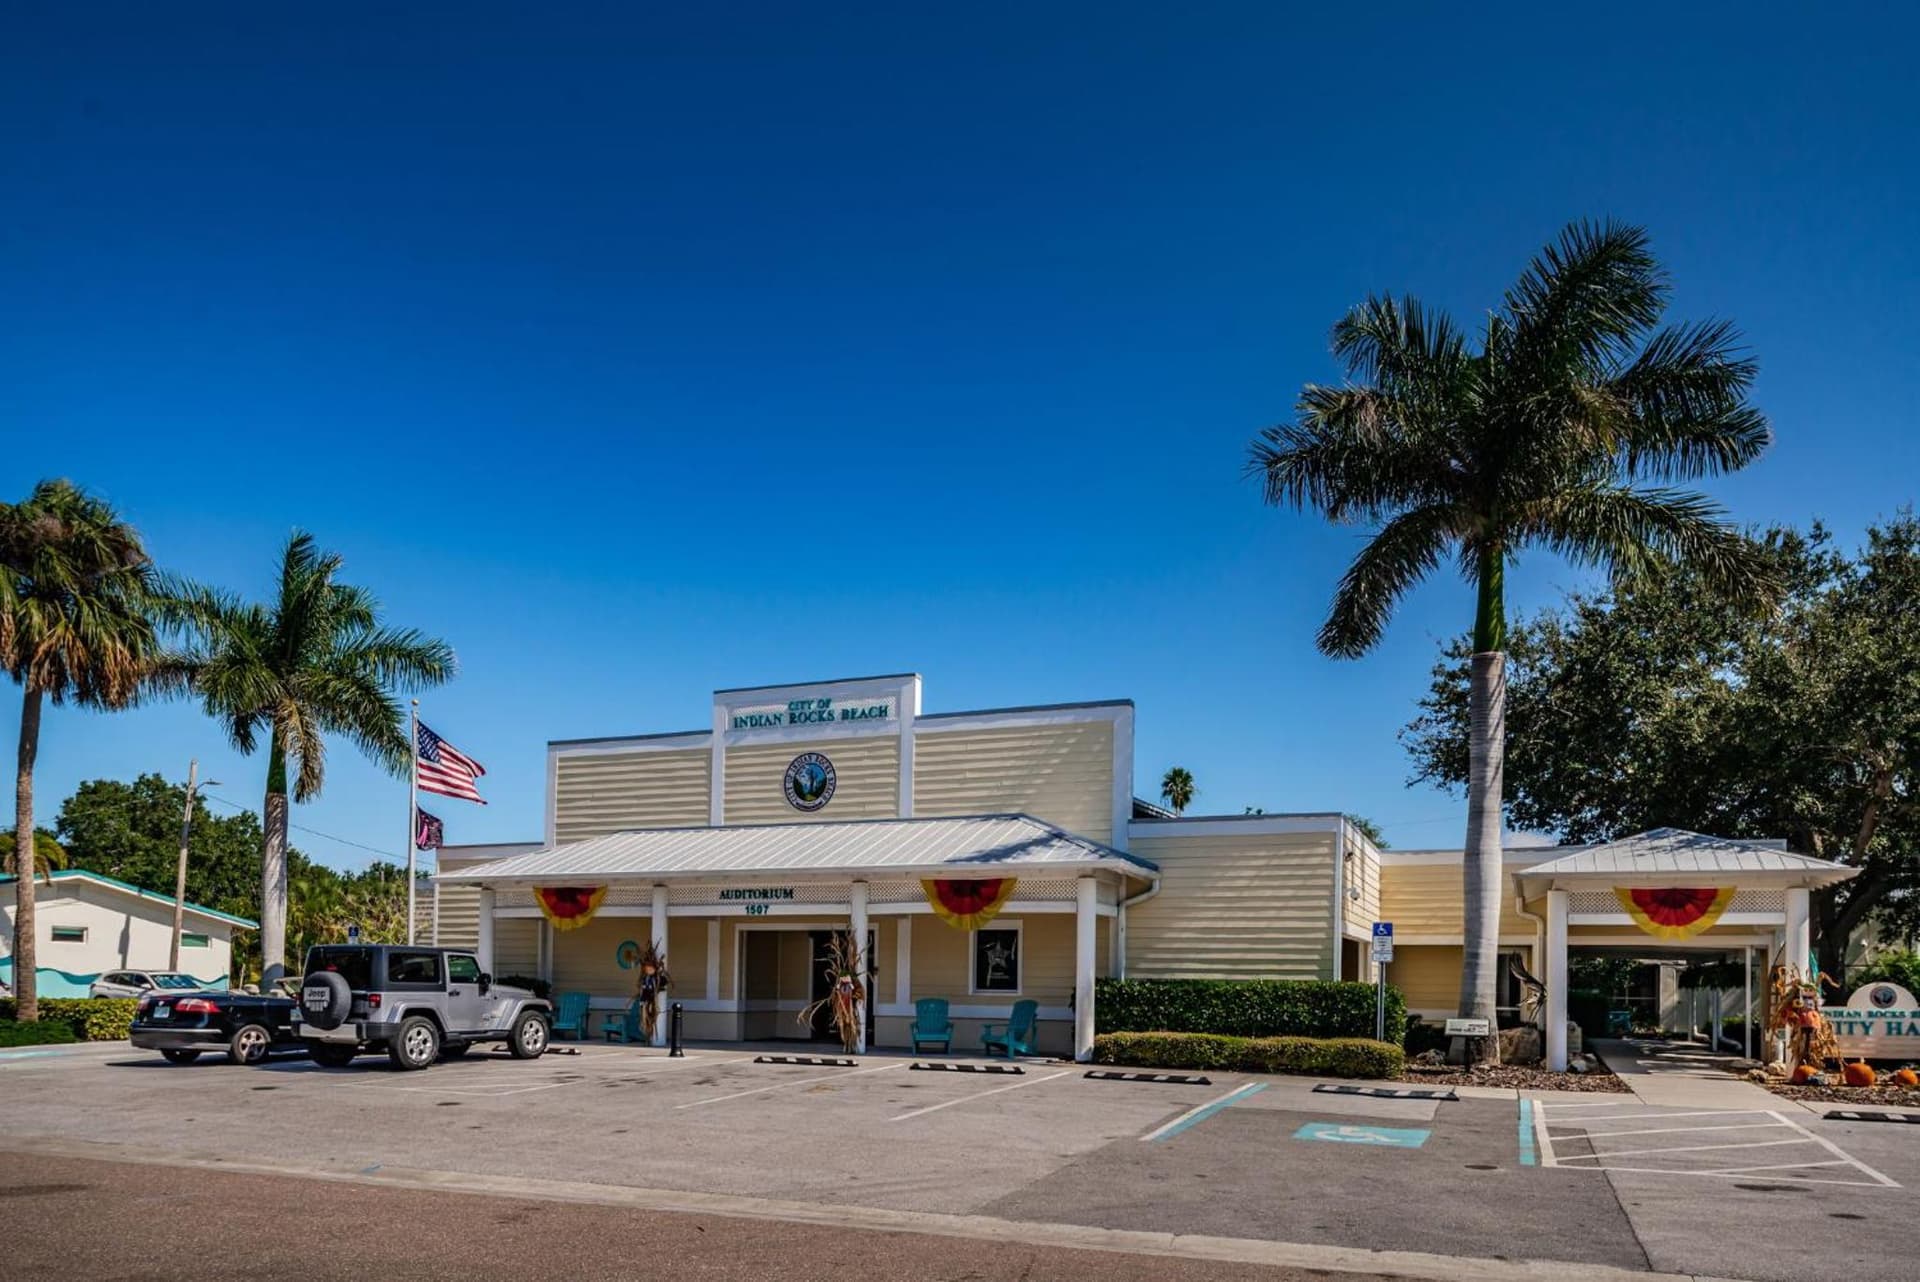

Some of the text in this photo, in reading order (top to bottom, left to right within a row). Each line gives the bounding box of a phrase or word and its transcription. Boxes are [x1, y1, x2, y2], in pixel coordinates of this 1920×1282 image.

[788, 698, 832, 711] CITY OF
[734, 705, 889, 728] INDIAN ROCKS BEACH
[719, 888, 794, 900] AUDITORIUM
[745, 904, 769, 915] 1507
[1823, 1010, 1862, 1018] NDIAN
[1867, 1010, 1906, 1018] ROCKS
[1833, 1020, 1920, 1036] ITY HA
